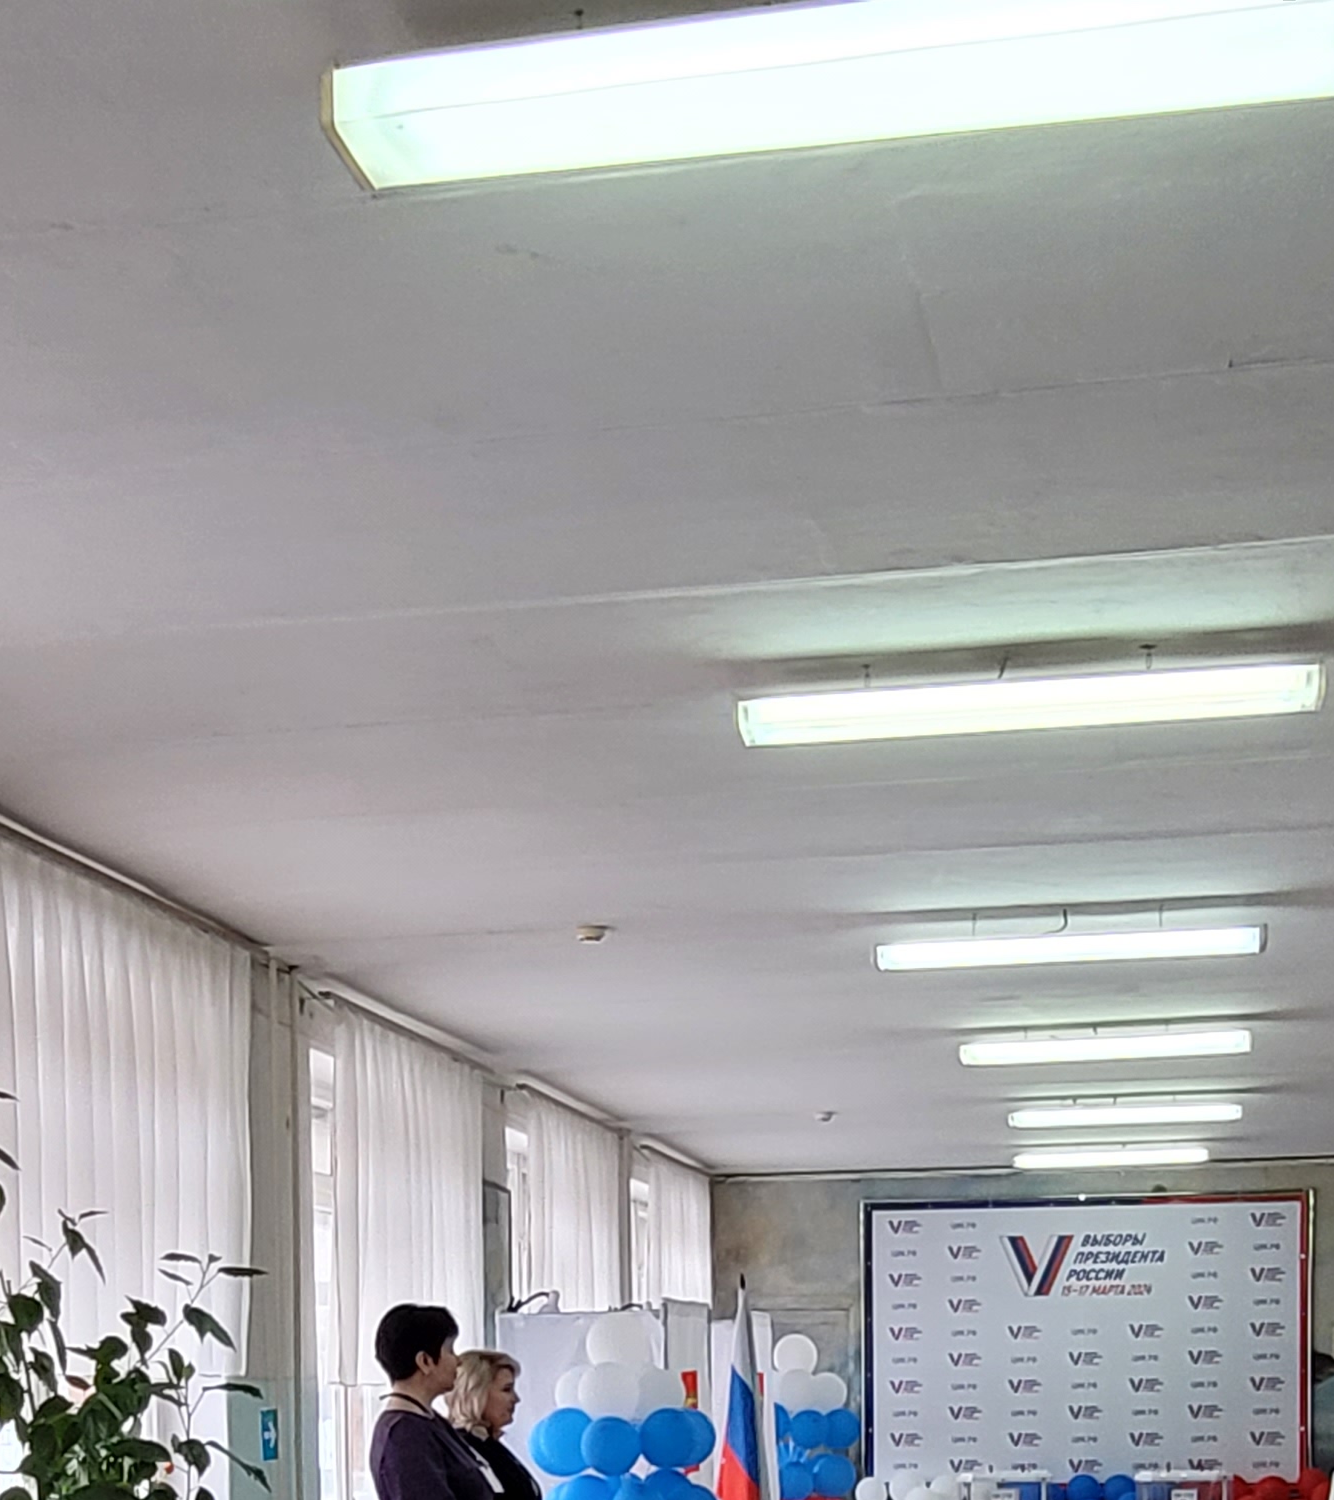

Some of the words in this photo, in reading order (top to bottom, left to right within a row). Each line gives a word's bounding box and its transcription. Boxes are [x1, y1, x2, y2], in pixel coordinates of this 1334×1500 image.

[1081, 1233, 1147, 1247] ВЫБОРЫ
[1073, 1250, 1166, 1265] ПРЕЗИДЕНТА
[1066, 1268, 1126, 1282] РОССИИ
[1091, 1284, 1126, 1296] МАРТА
